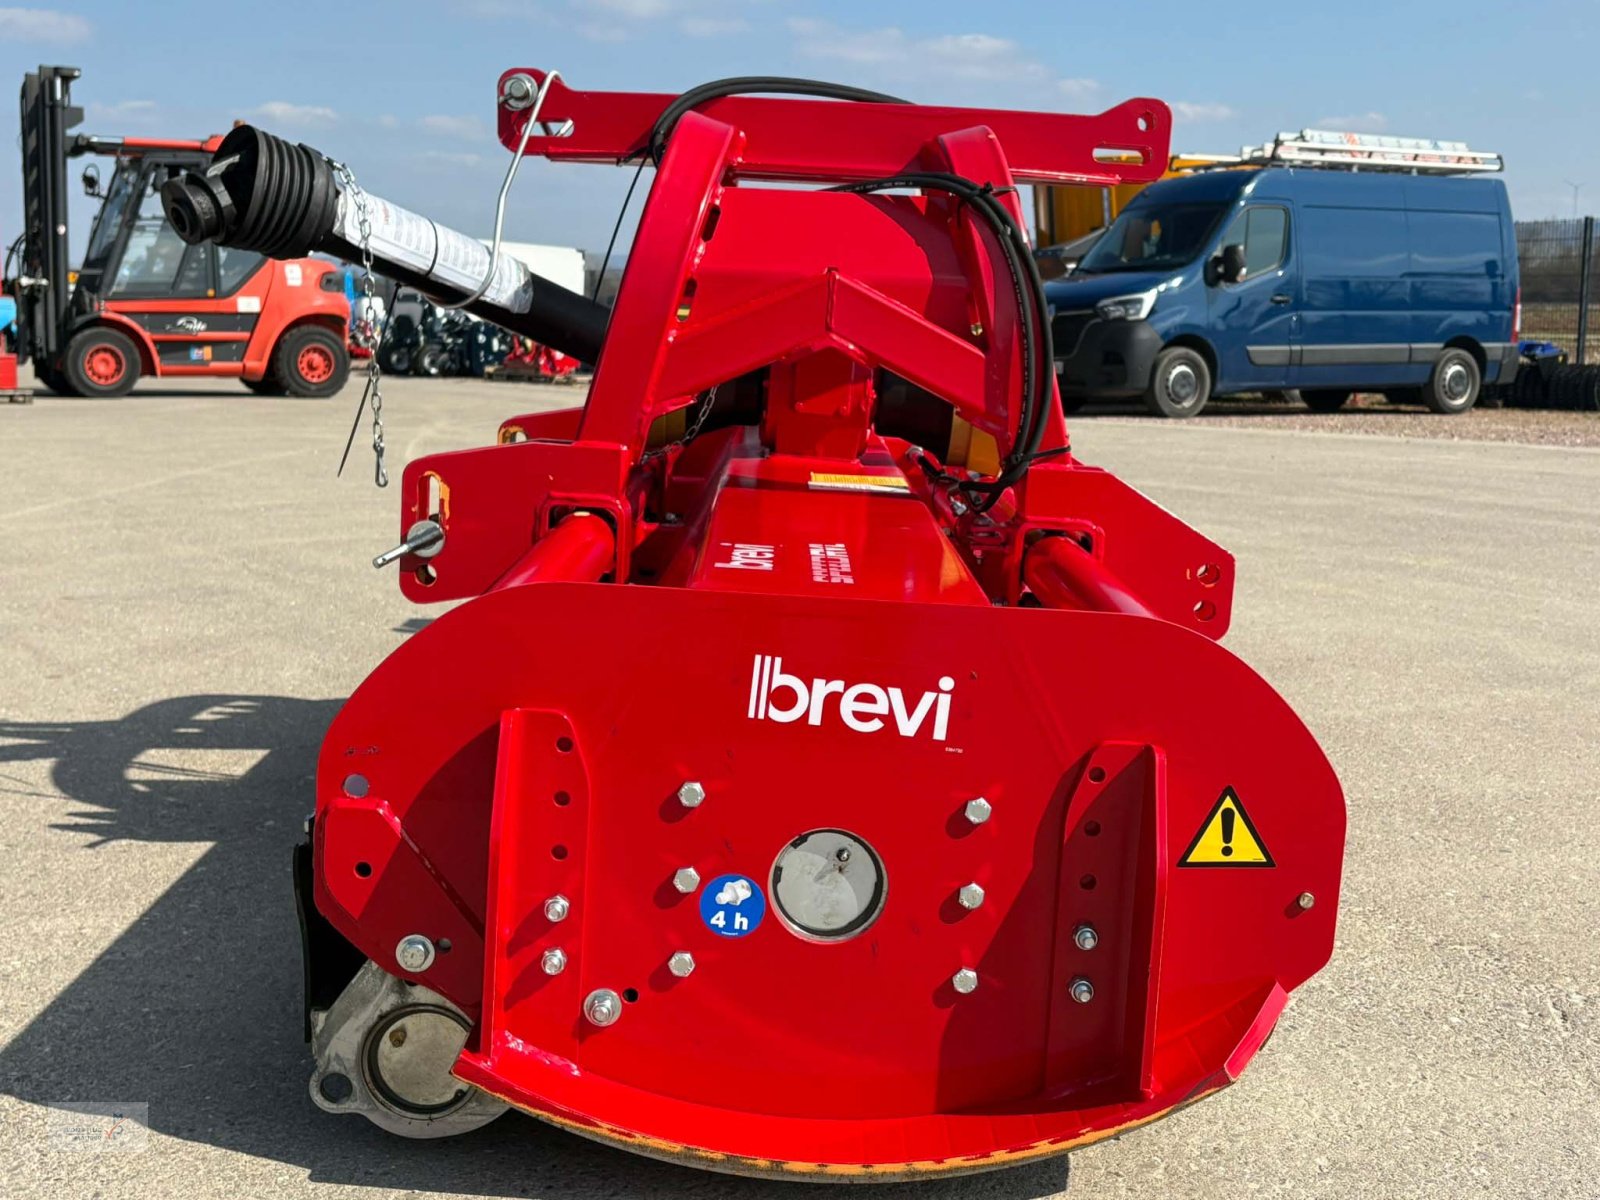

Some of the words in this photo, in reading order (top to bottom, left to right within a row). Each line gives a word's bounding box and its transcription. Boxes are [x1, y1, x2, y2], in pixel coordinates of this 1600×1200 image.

[714, 542, 775, 571] brevi
[748, 654, 955, 741] brevi
[710, 910, 726, 929] 4
[734, 911, 749, 931] h
